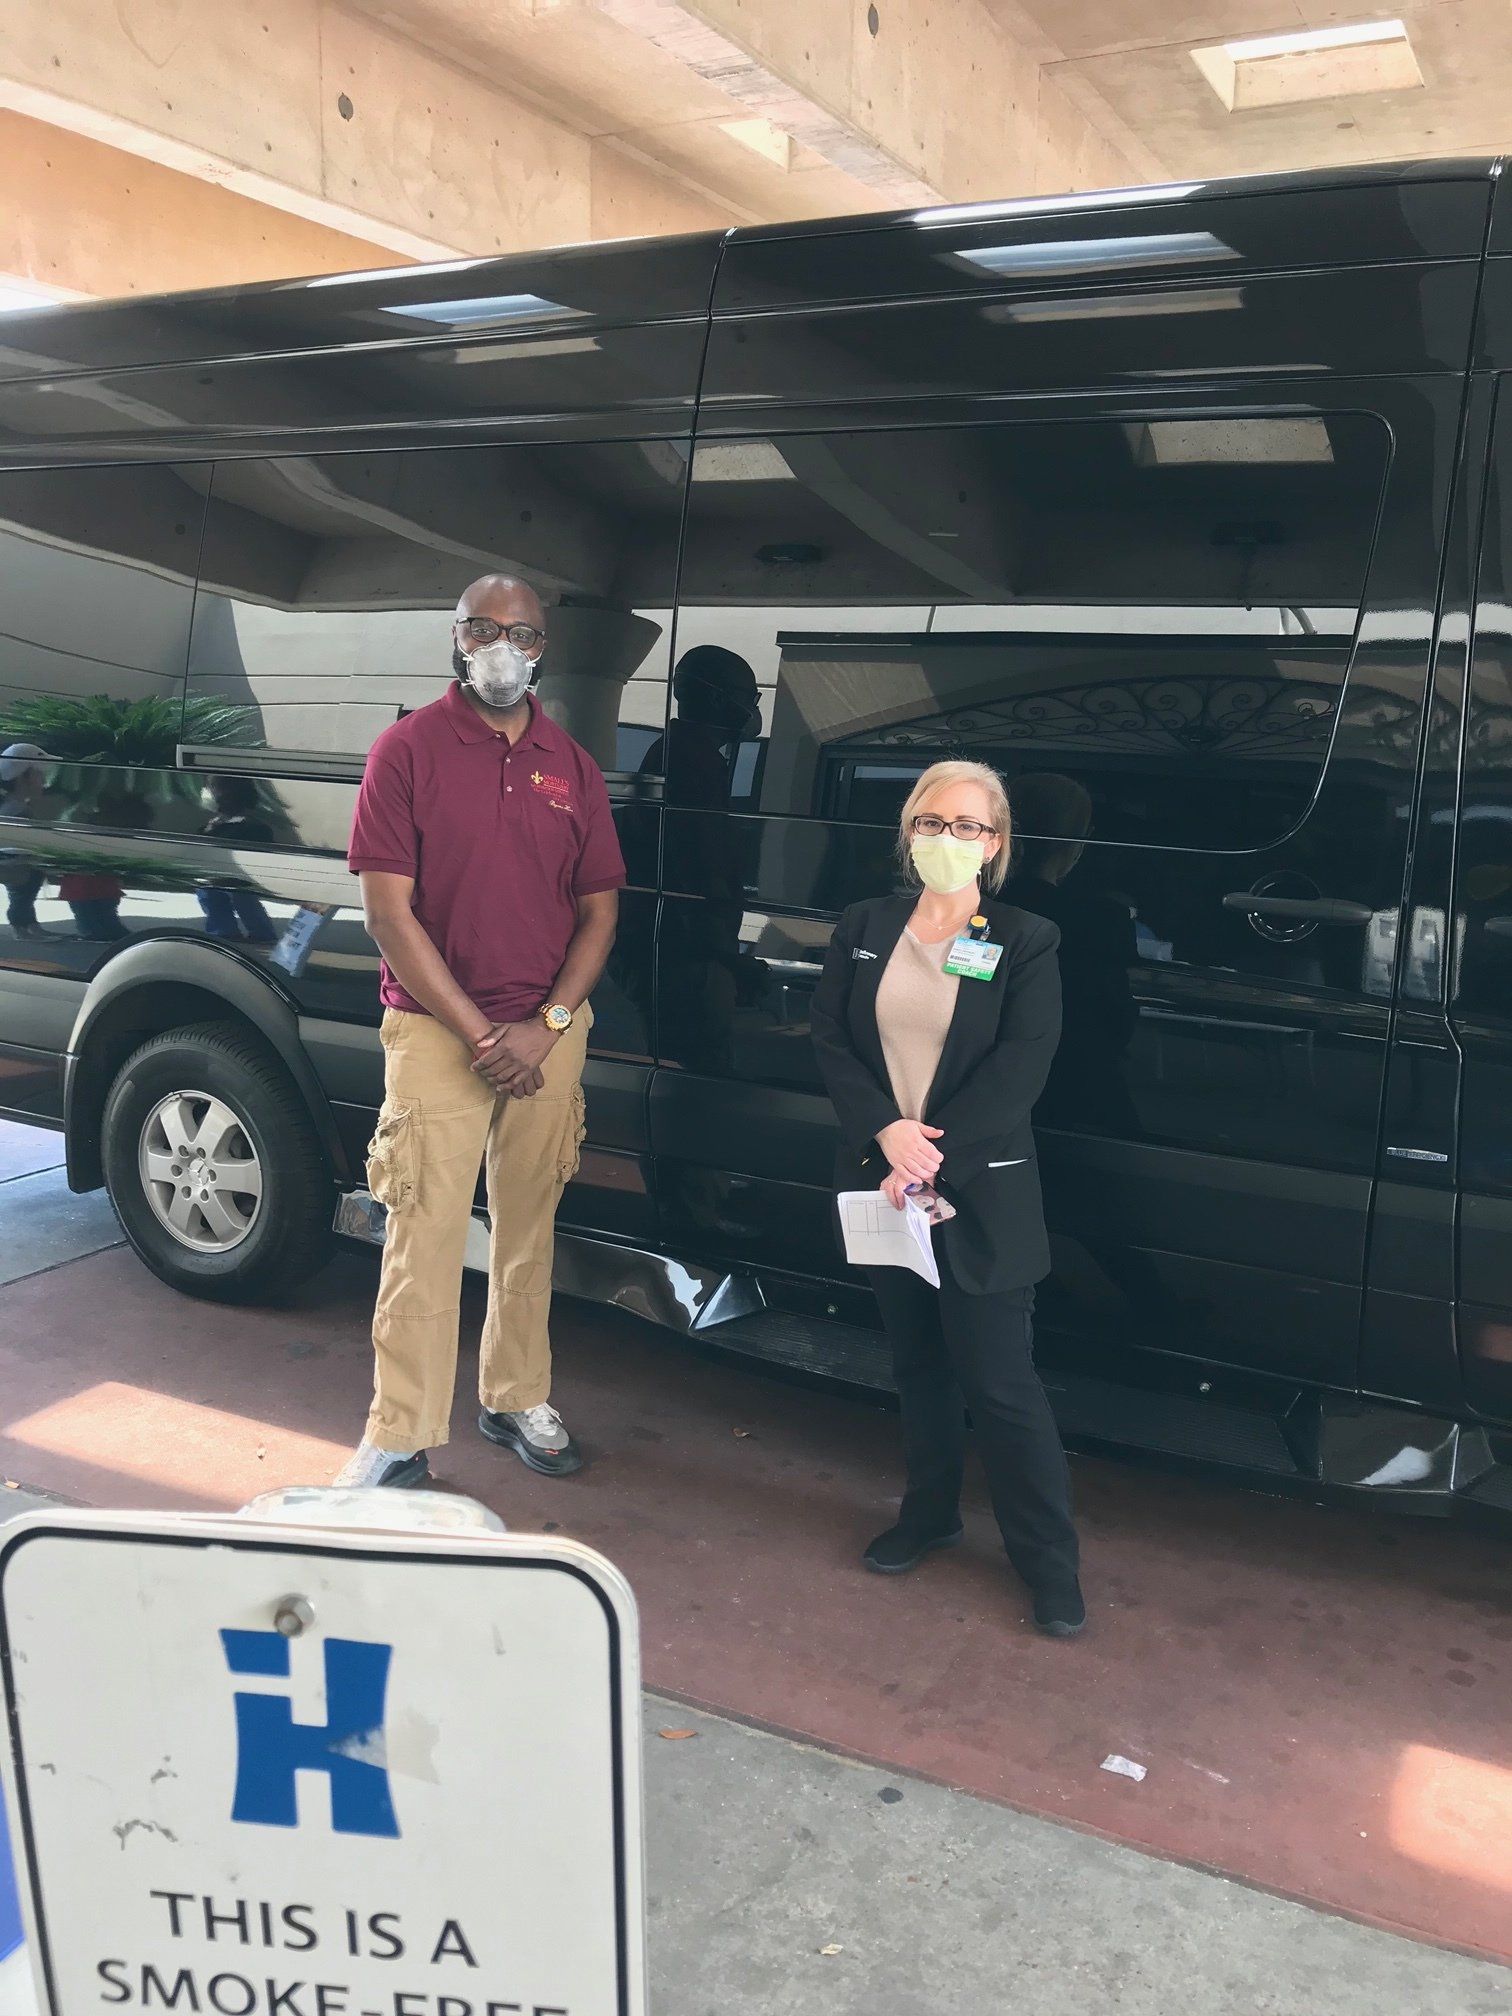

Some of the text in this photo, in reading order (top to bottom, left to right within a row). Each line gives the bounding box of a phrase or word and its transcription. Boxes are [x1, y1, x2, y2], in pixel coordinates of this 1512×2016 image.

[946, 962, 970, 972] PATIENT
[150, 1890, 479, 1968] THIS IS A
[97, 1958, 569, 2016] SMOKE-F
